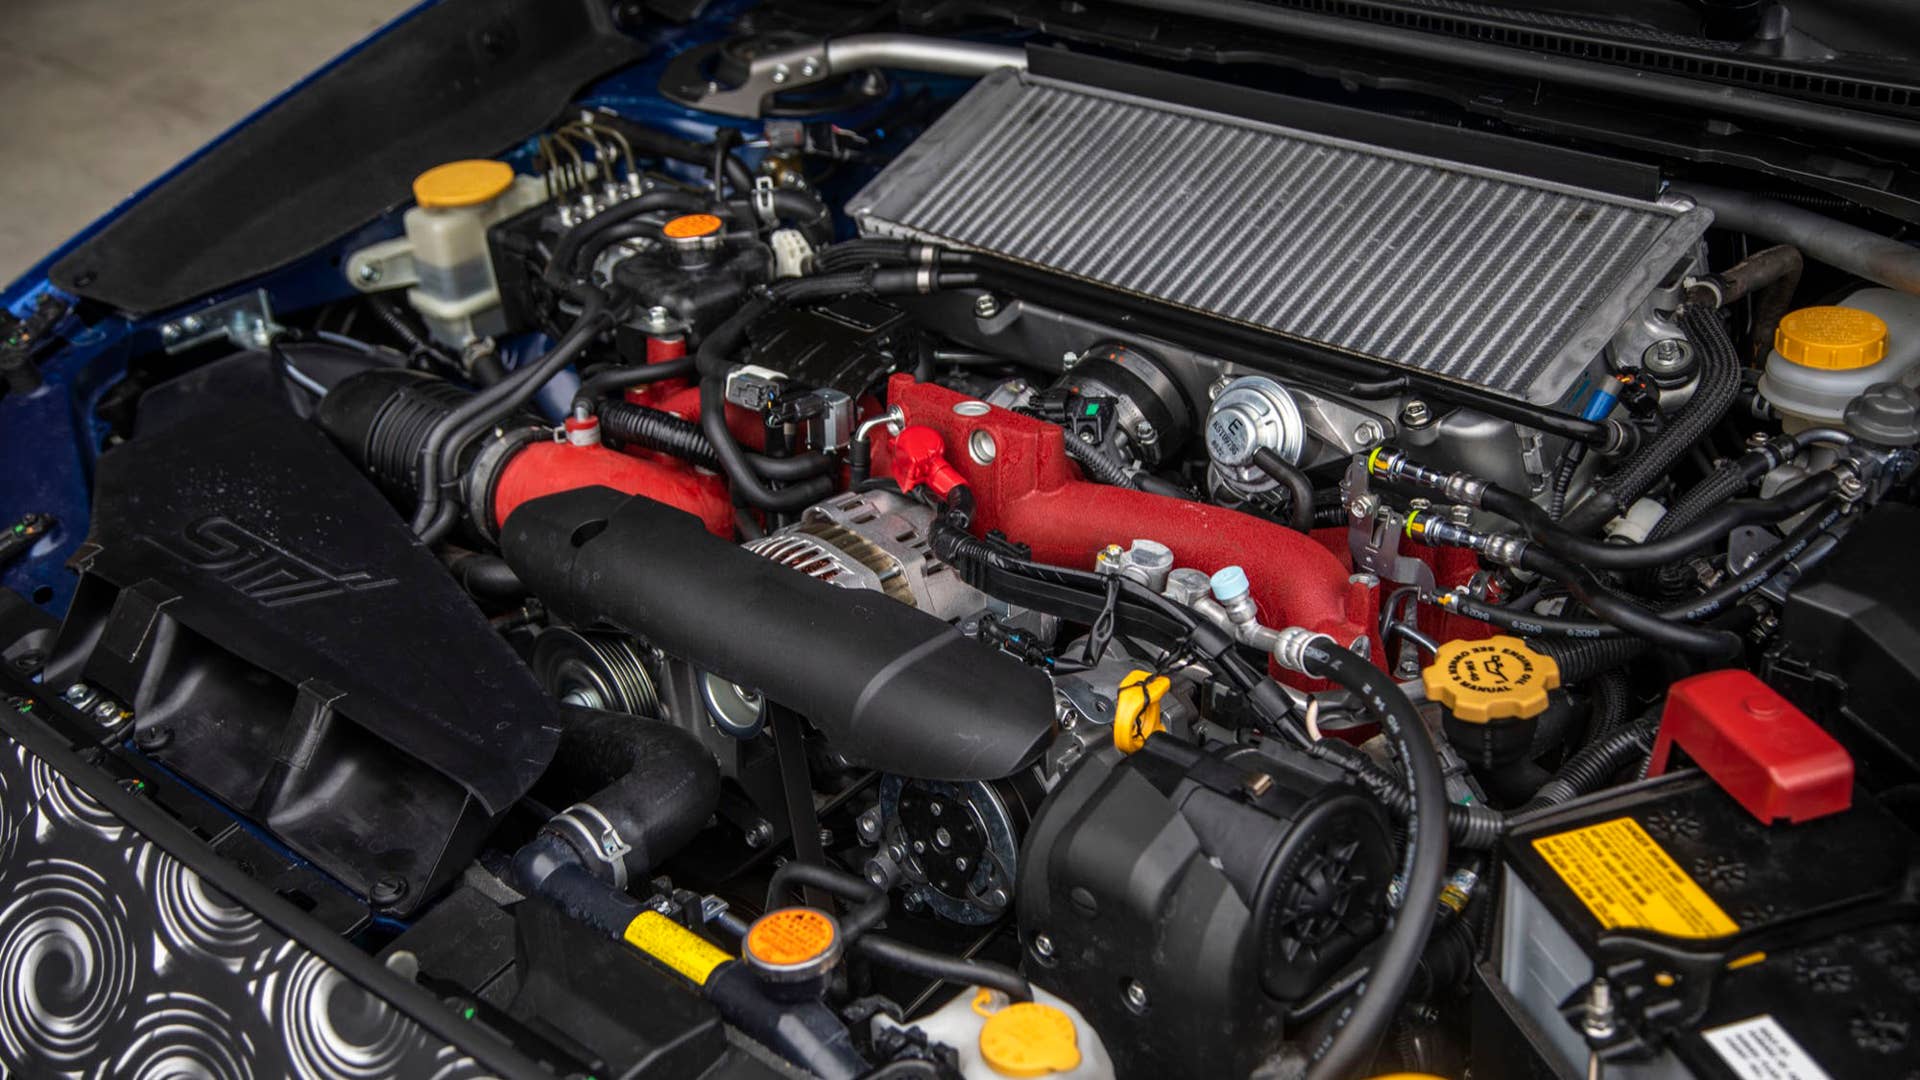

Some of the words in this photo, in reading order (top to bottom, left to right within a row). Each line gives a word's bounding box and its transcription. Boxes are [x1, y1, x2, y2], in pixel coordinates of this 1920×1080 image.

[1228, 418, 1243, 436] E
[1501, 648, 1533, 671] ENGINE
[1460, 681, 1512, 693] MANUAL
[1515, 674, 1532, 685] OIL
